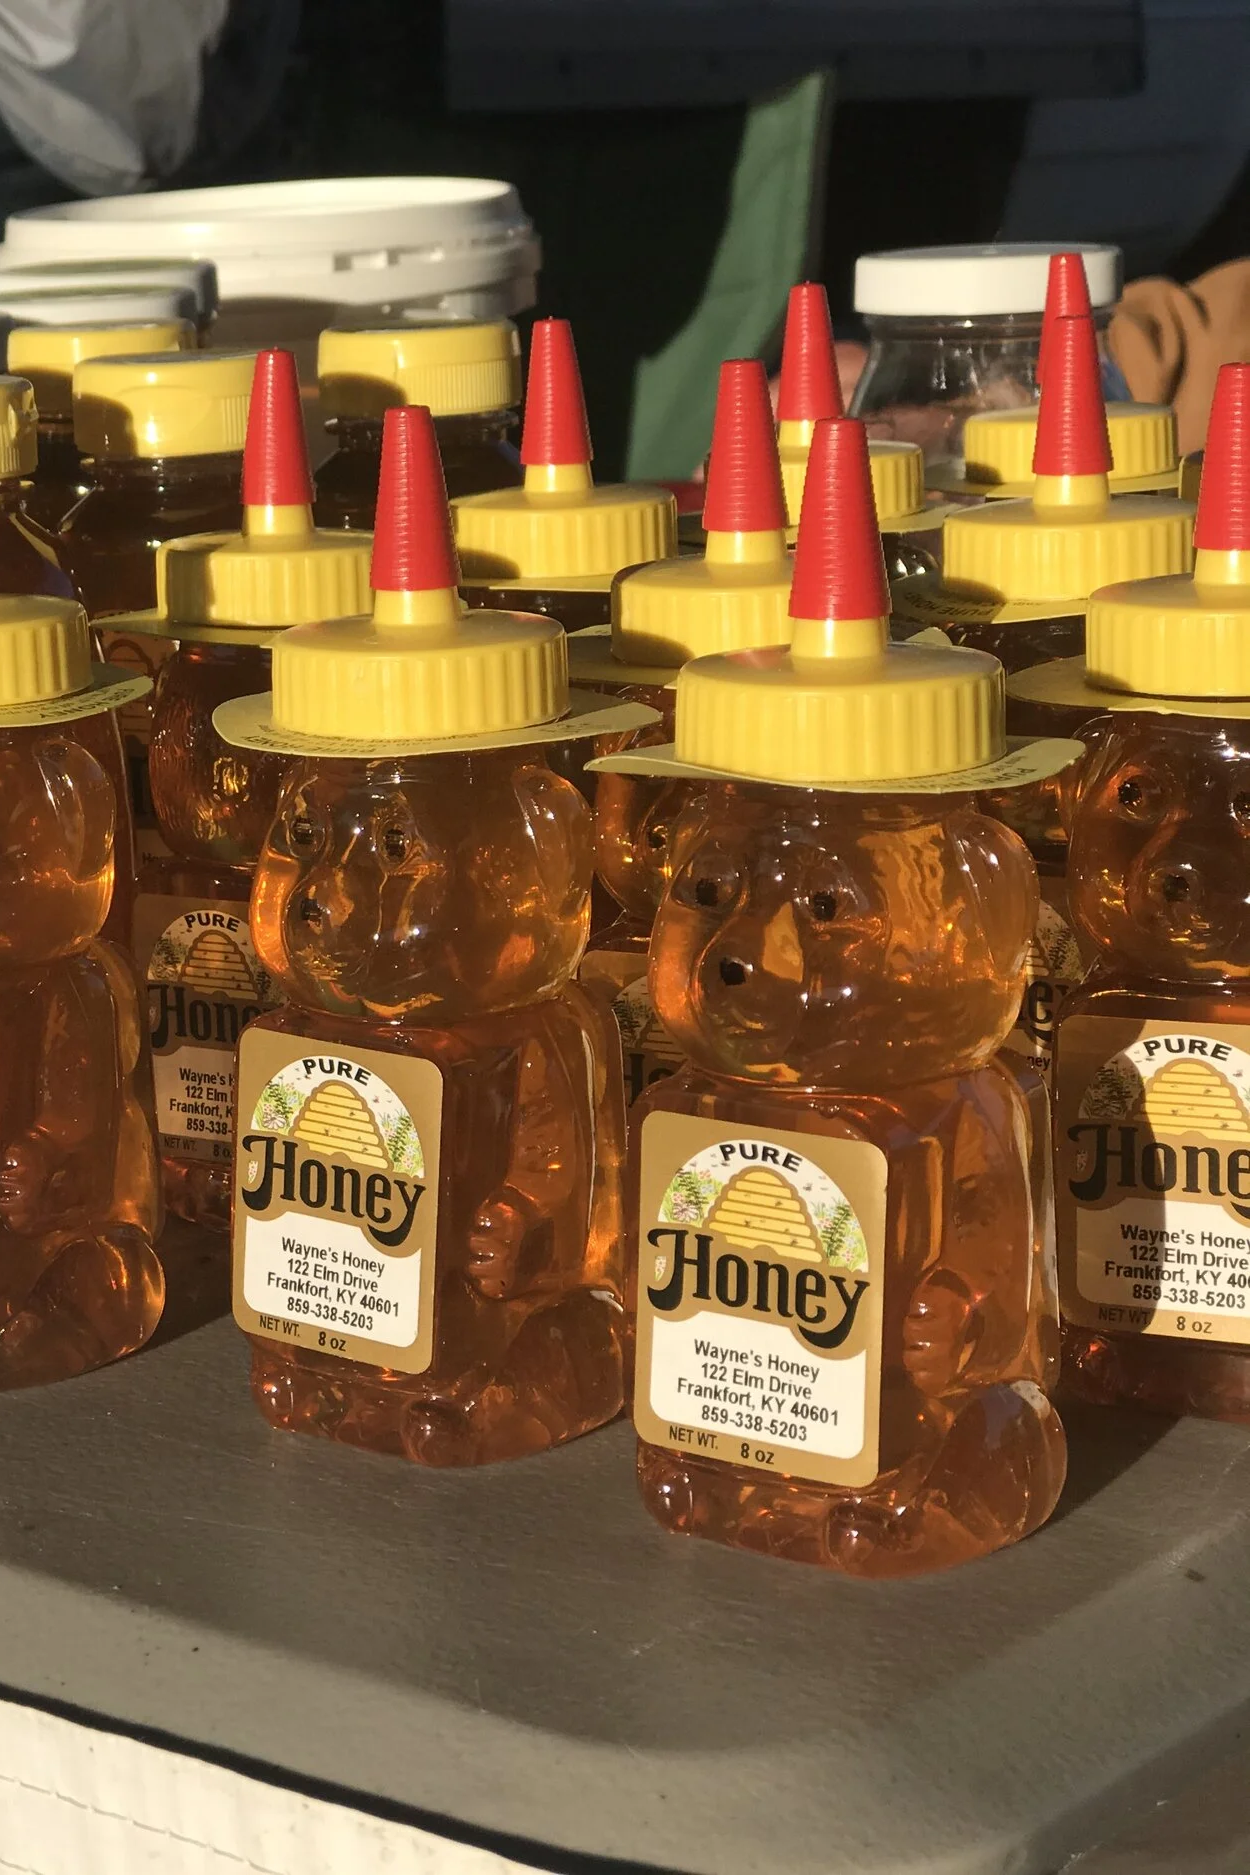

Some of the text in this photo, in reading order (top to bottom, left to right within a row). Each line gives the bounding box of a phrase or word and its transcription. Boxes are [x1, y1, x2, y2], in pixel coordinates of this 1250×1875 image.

[184, 912, 240, 933] PURE
[1143, 1038, 1232, 1062] PURE
[179, 1068, 226, 1086] Wayne's
[302, 1058, 372, 1087] PURE
[185, 1085, 203, 1100] 122
[206, 1088, 228, 1102] Elm
[170, 1099, 222, 1119] Frankfort,
[186, 1118, 233, 1135] 859-338-
[164, 1137, 181, 1148] NET
[213, 1145, 220, 1157] 8
[718, 1143, 803, 1173] PURE
[1067, 1123, 1250, 1222] Hone
[241, 1134, 427, 1247] Honey
[1120, 1224, 1250, 1254] Wayne's Hone
[282, 1236, 385, 1278] Wayne's Honey
[1130, 1245, 1249, 1270] 122 Elm Drive
[287, 1258, 379, 1293] 122 Elm Drive
[1105, 1261, 1190, 1286] Frankfort,
[1196, 1270, 1222, 1286] KY
[267, 1272, 399, 1317] Frankfort, KY 40601
[647, 1228, 871, 1350] Honey
[1132, 1284, 1246, 1310] 859-338-5203
[287, 1297, 374, 1331] 859-338-5203
[1099, 1307, 1125, 1323] NET
[1176, 1316, 1187, 1331] 8
[1192, 1321, 1213, 1334] oz
[259, 1315, 347, 1352] NET WT. 8 oz
[694, 1338, 820, 1384] Wayne's Honey
[701, 1362, 812, 1400] 122 Elm Drive
[677, 1377, 839, 1426] Frankfort, KY 40601
[701, 1404, 807, 1442] 859-338-5203
[669, 1425, 775, 1465] NET WT. 8 oz
